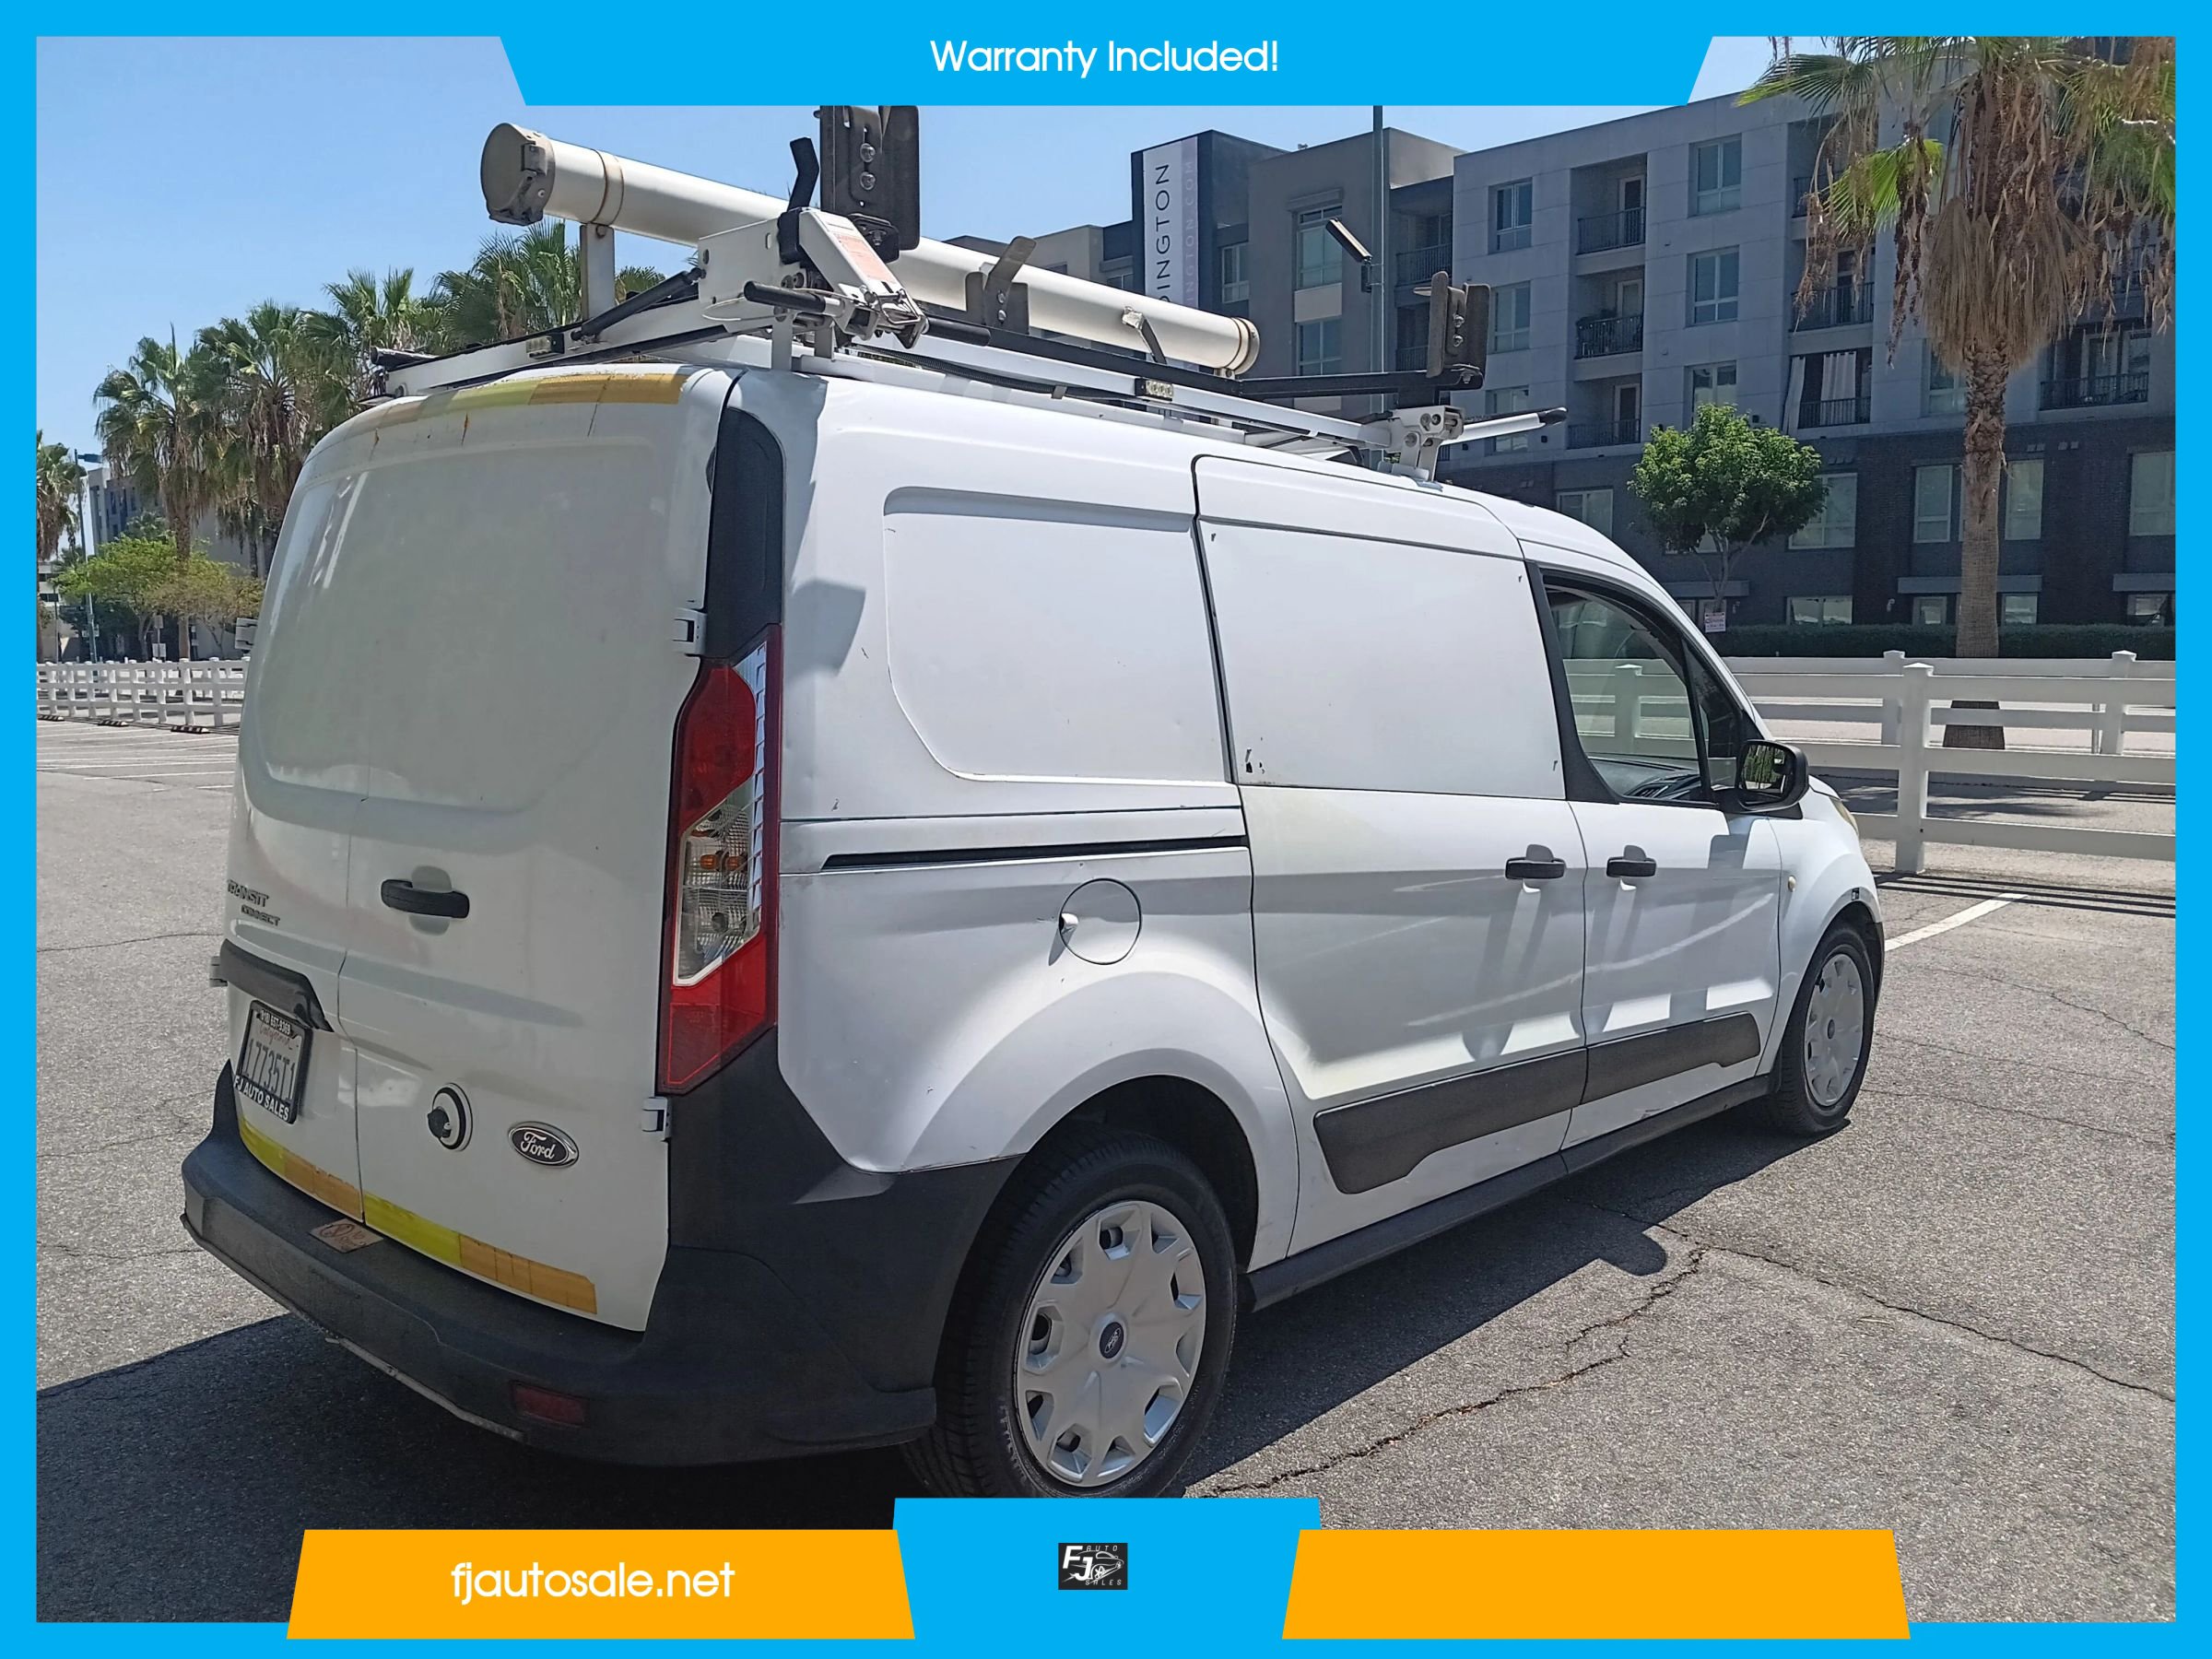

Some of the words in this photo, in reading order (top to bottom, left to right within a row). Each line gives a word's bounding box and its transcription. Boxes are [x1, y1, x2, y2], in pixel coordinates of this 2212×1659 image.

[233, 1075, 243, 1091] FJ
[243, 1084, 264, 1104] AUTO
[265, 1095, 289, 1122] SALES
[521, 1132, 556, 1159] Ford
